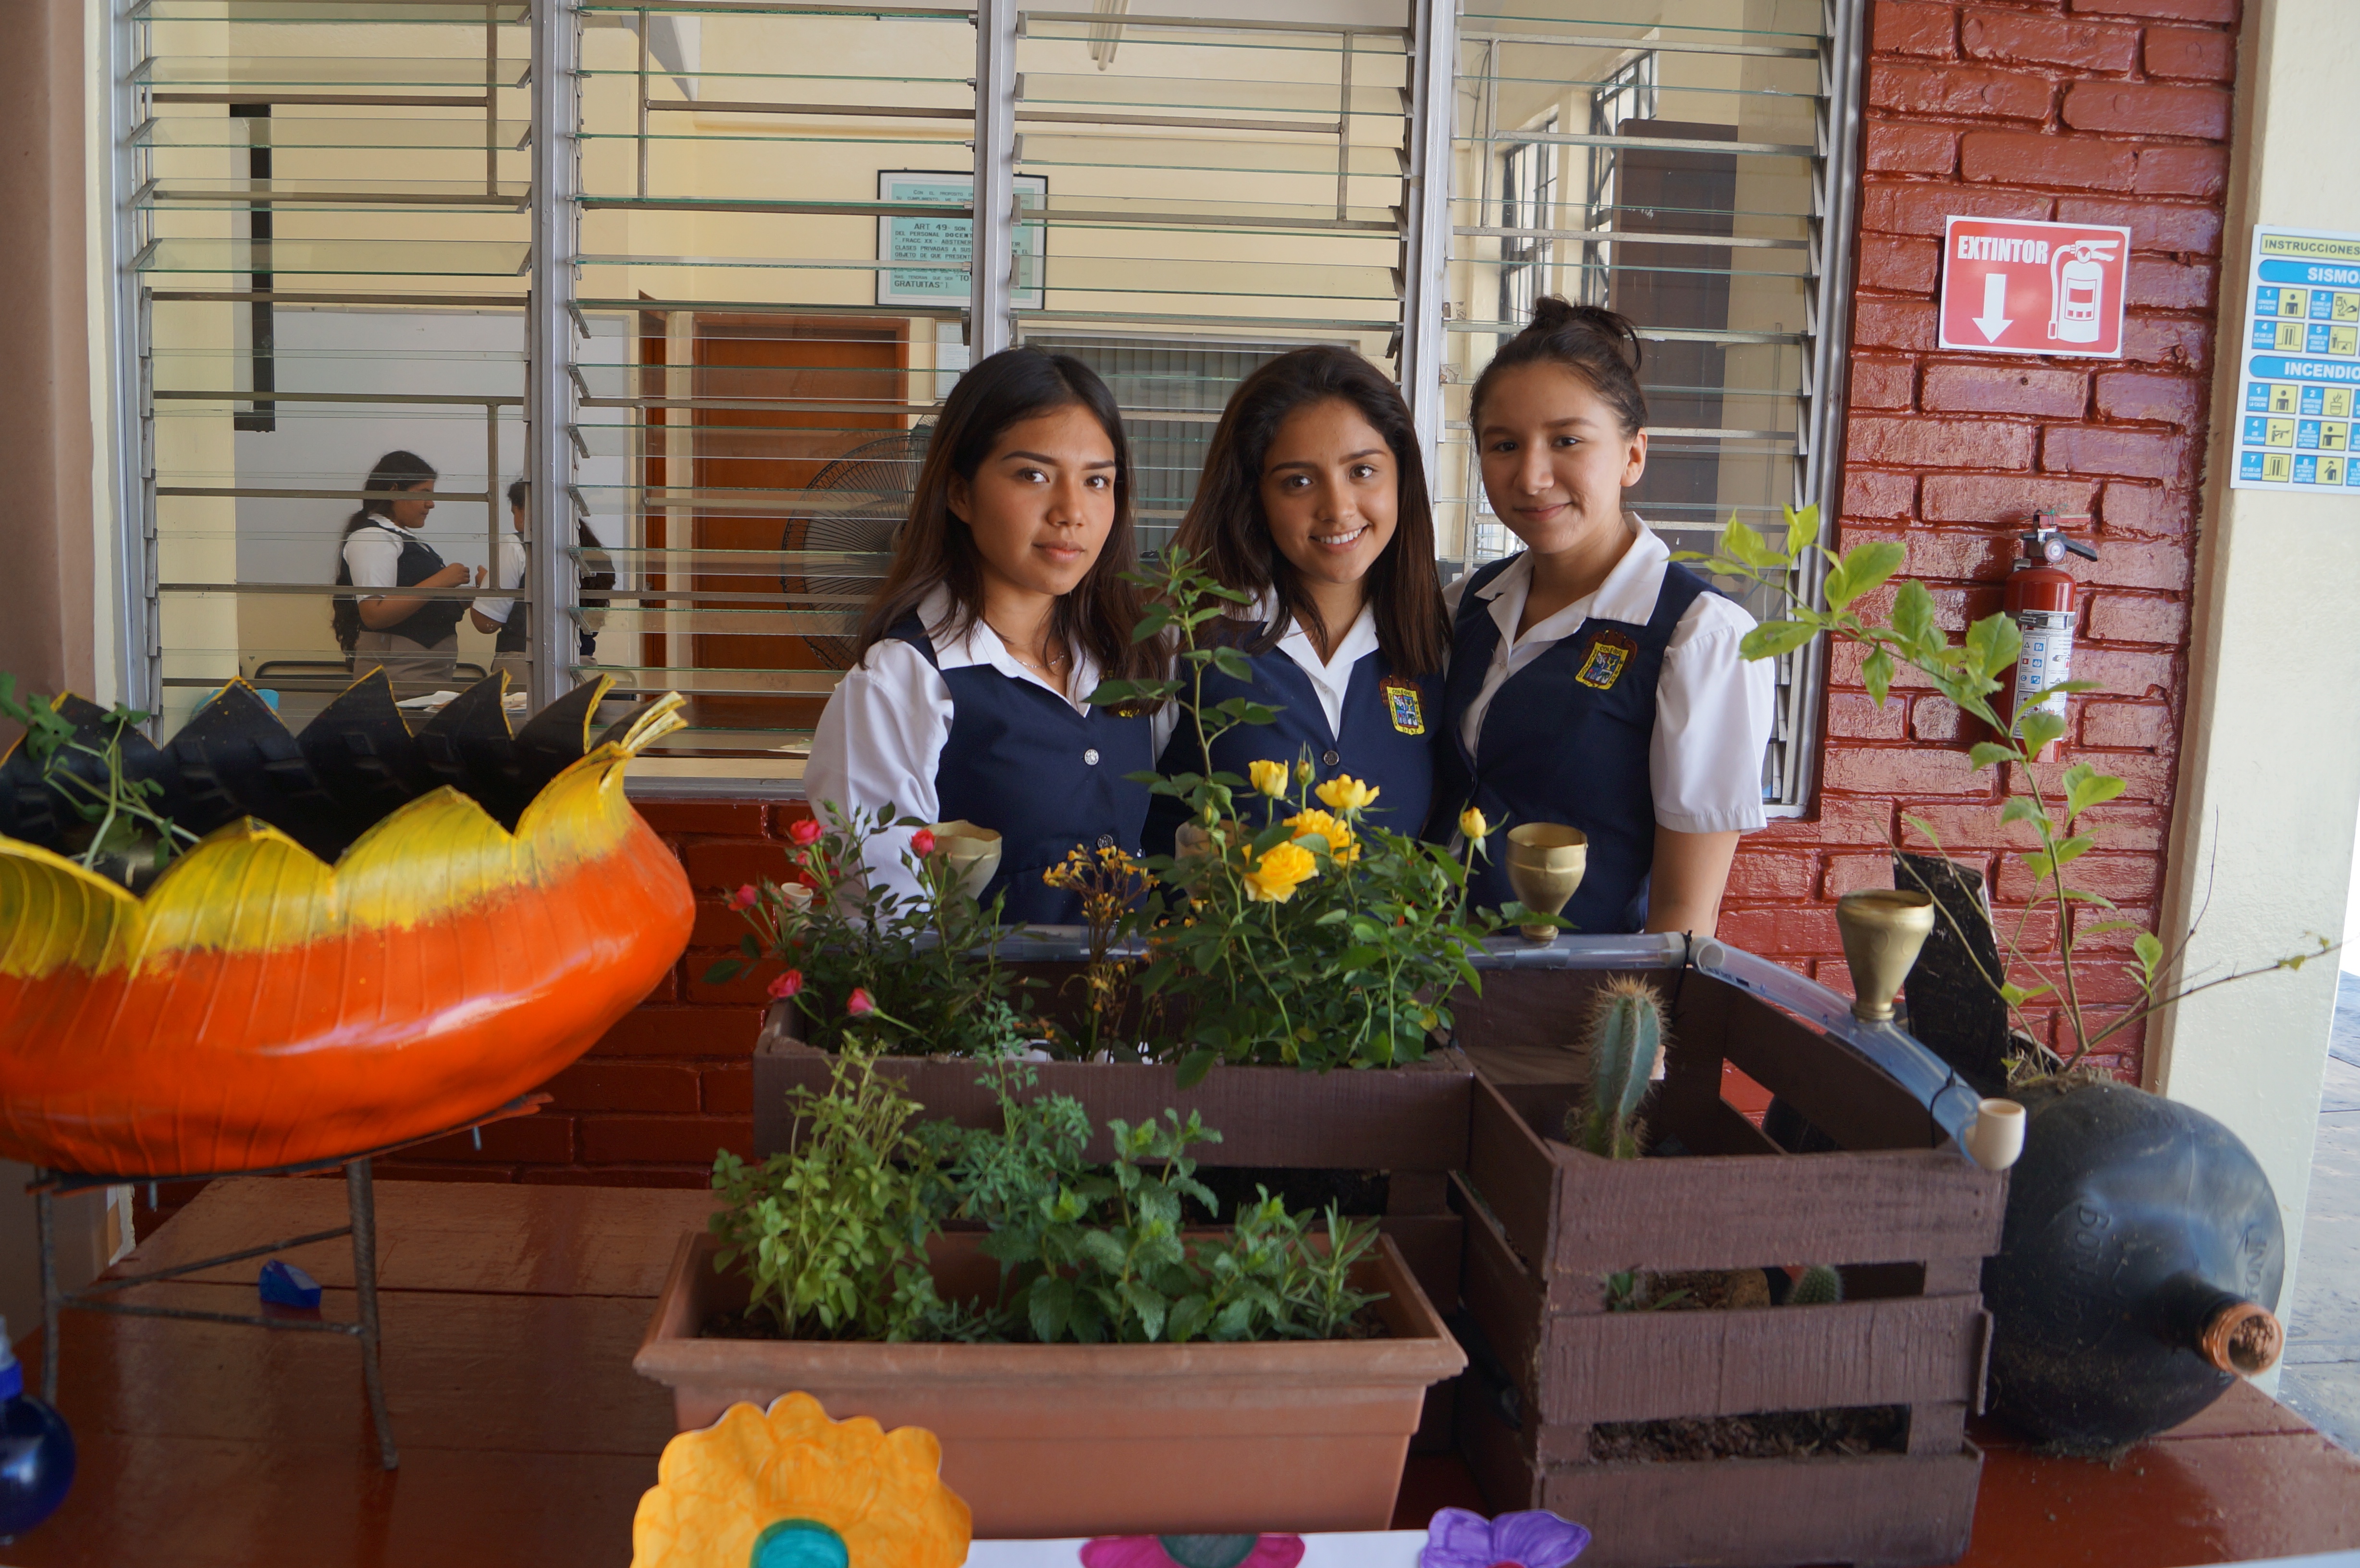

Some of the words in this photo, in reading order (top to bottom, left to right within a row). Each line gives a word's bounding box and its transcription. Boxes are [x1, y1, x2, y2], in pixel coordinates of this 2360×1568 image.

[1957, 235, 2049, 264] EXTINTOR
[2264, 239, 2360, 255] INSTRUCCIONES
[2307, 267, 2360, 284] SISMO
